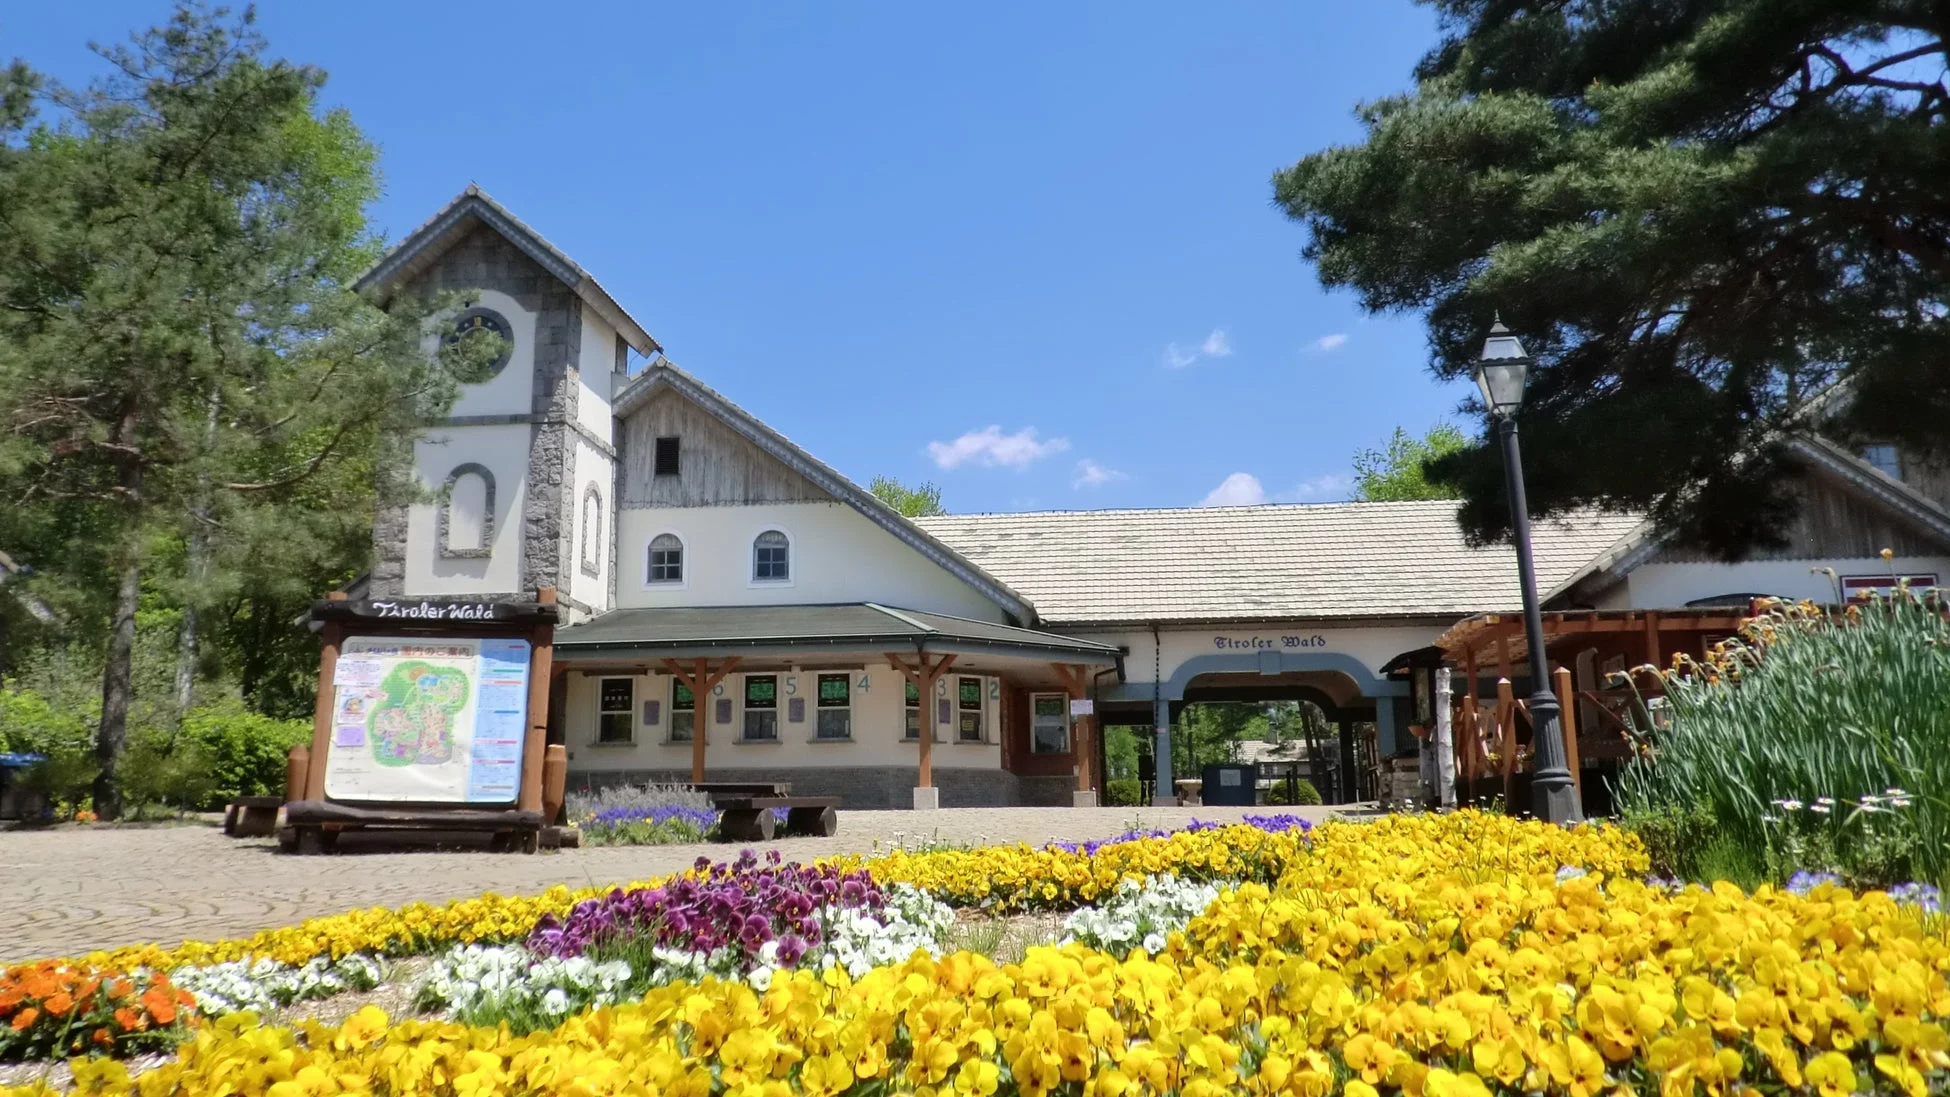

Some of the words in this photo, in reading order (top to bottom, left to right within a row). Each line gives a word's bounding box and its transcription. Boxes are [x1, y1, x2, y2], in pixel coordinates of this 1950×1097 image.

[1214, 636, 1273, 649] Tiroler
[1281, 635, 1326, 647] Wald
[712, 679, 724, 696] 6
[785, 677, 797, 695] 5
[857, 675, 871, 692] 4
[937, 679, 946, 697] 3
[990, 681, 1000, 700] 2
